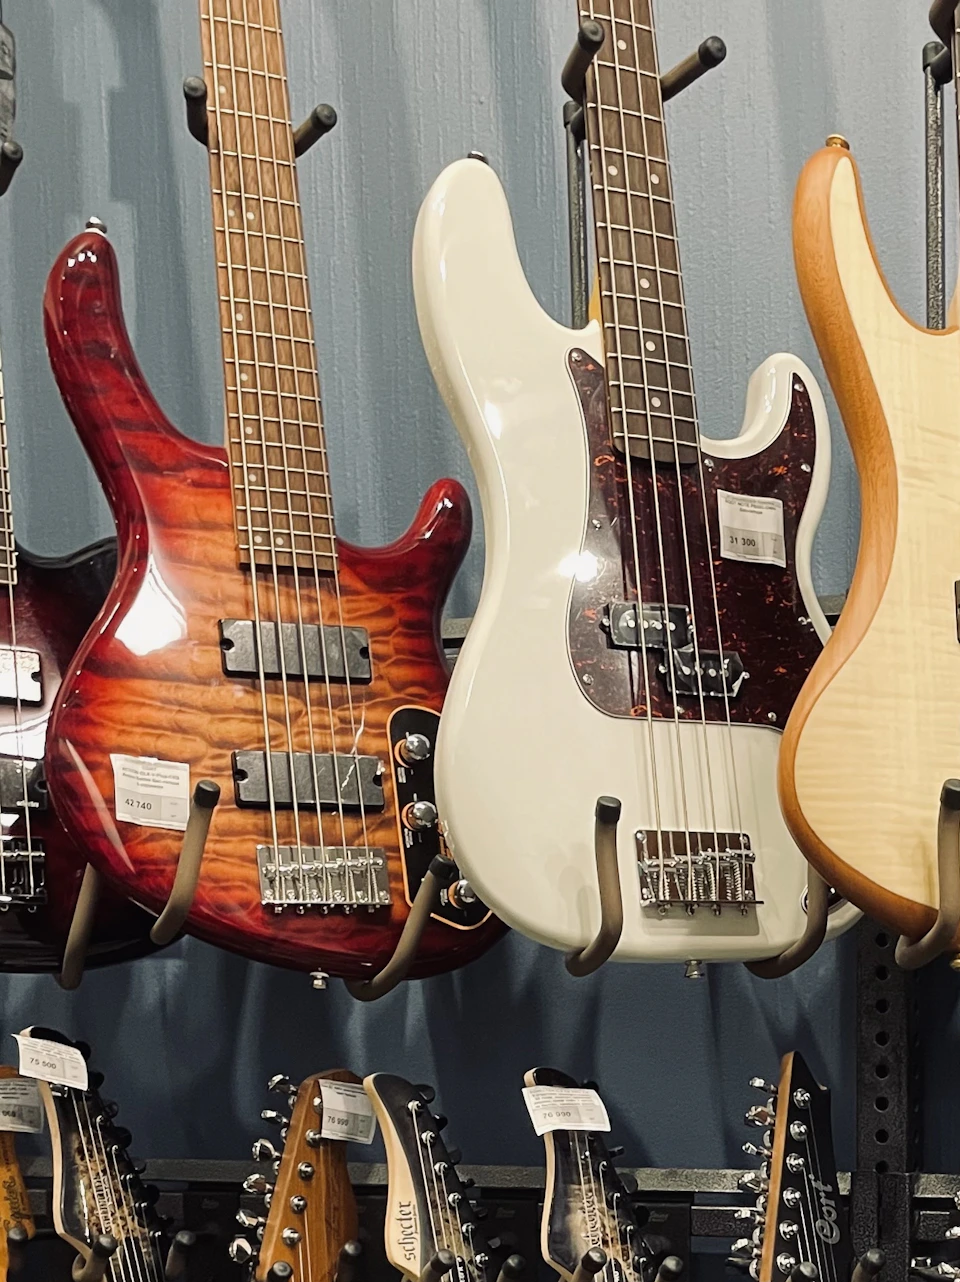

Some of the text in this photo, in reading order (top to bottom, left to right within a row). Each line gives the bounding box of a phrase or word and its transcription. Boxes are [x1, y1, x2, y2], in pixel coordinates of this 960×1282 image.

[730, 536, 756, 547] 31 300
[125, 798, 152, 811] 42 740
[29, 1057, 57, 1070] 75 500
[327, 1116, 336, 1124] 76
[808, 1173, 841, 1245] Cort
[396, 1200, 417, 1262] schecter
